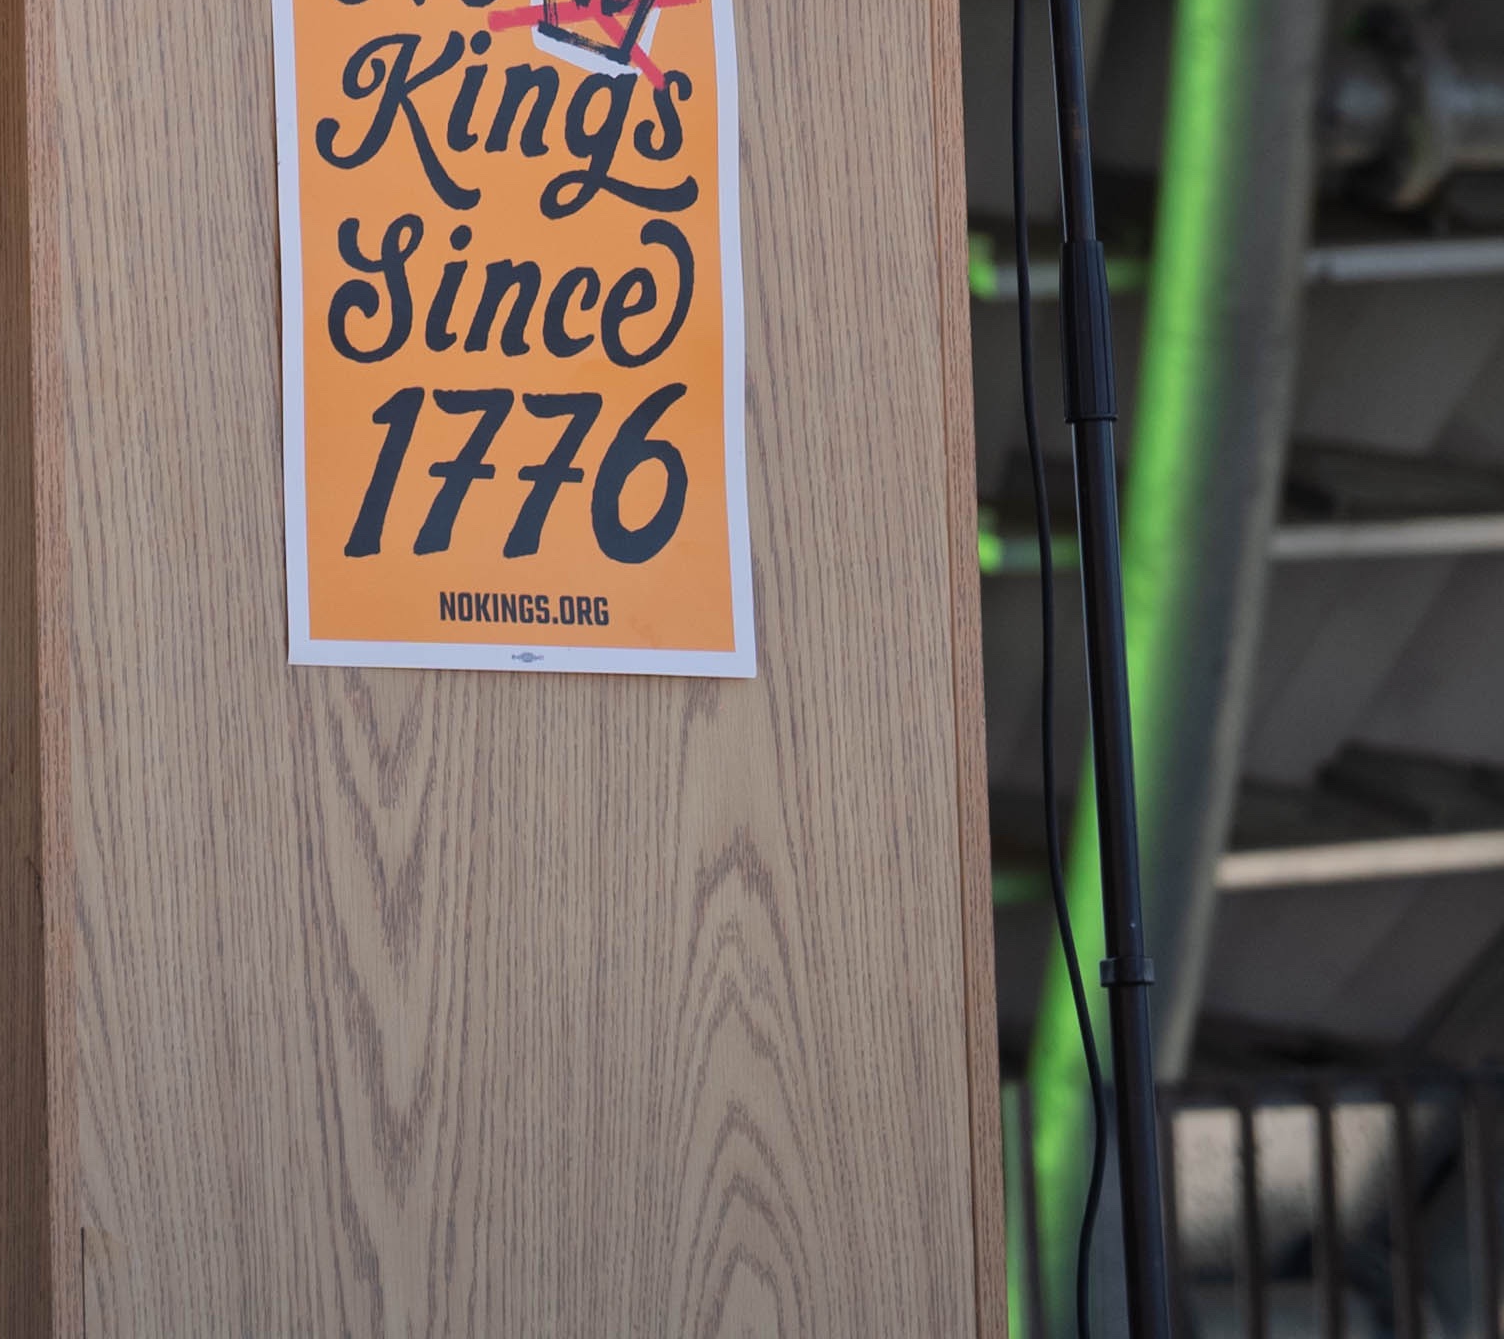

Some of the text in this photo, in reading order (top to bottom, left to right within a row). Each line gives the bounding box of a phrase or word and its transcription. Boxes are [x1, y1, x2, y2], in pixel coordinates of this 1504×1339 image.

[315, 30, 699, 220] Kings
[328, 214, 695, 368] Since
[344, 382, 688, 564] 1776
[439, 591, 610, 627] NOKINGS.ORG
